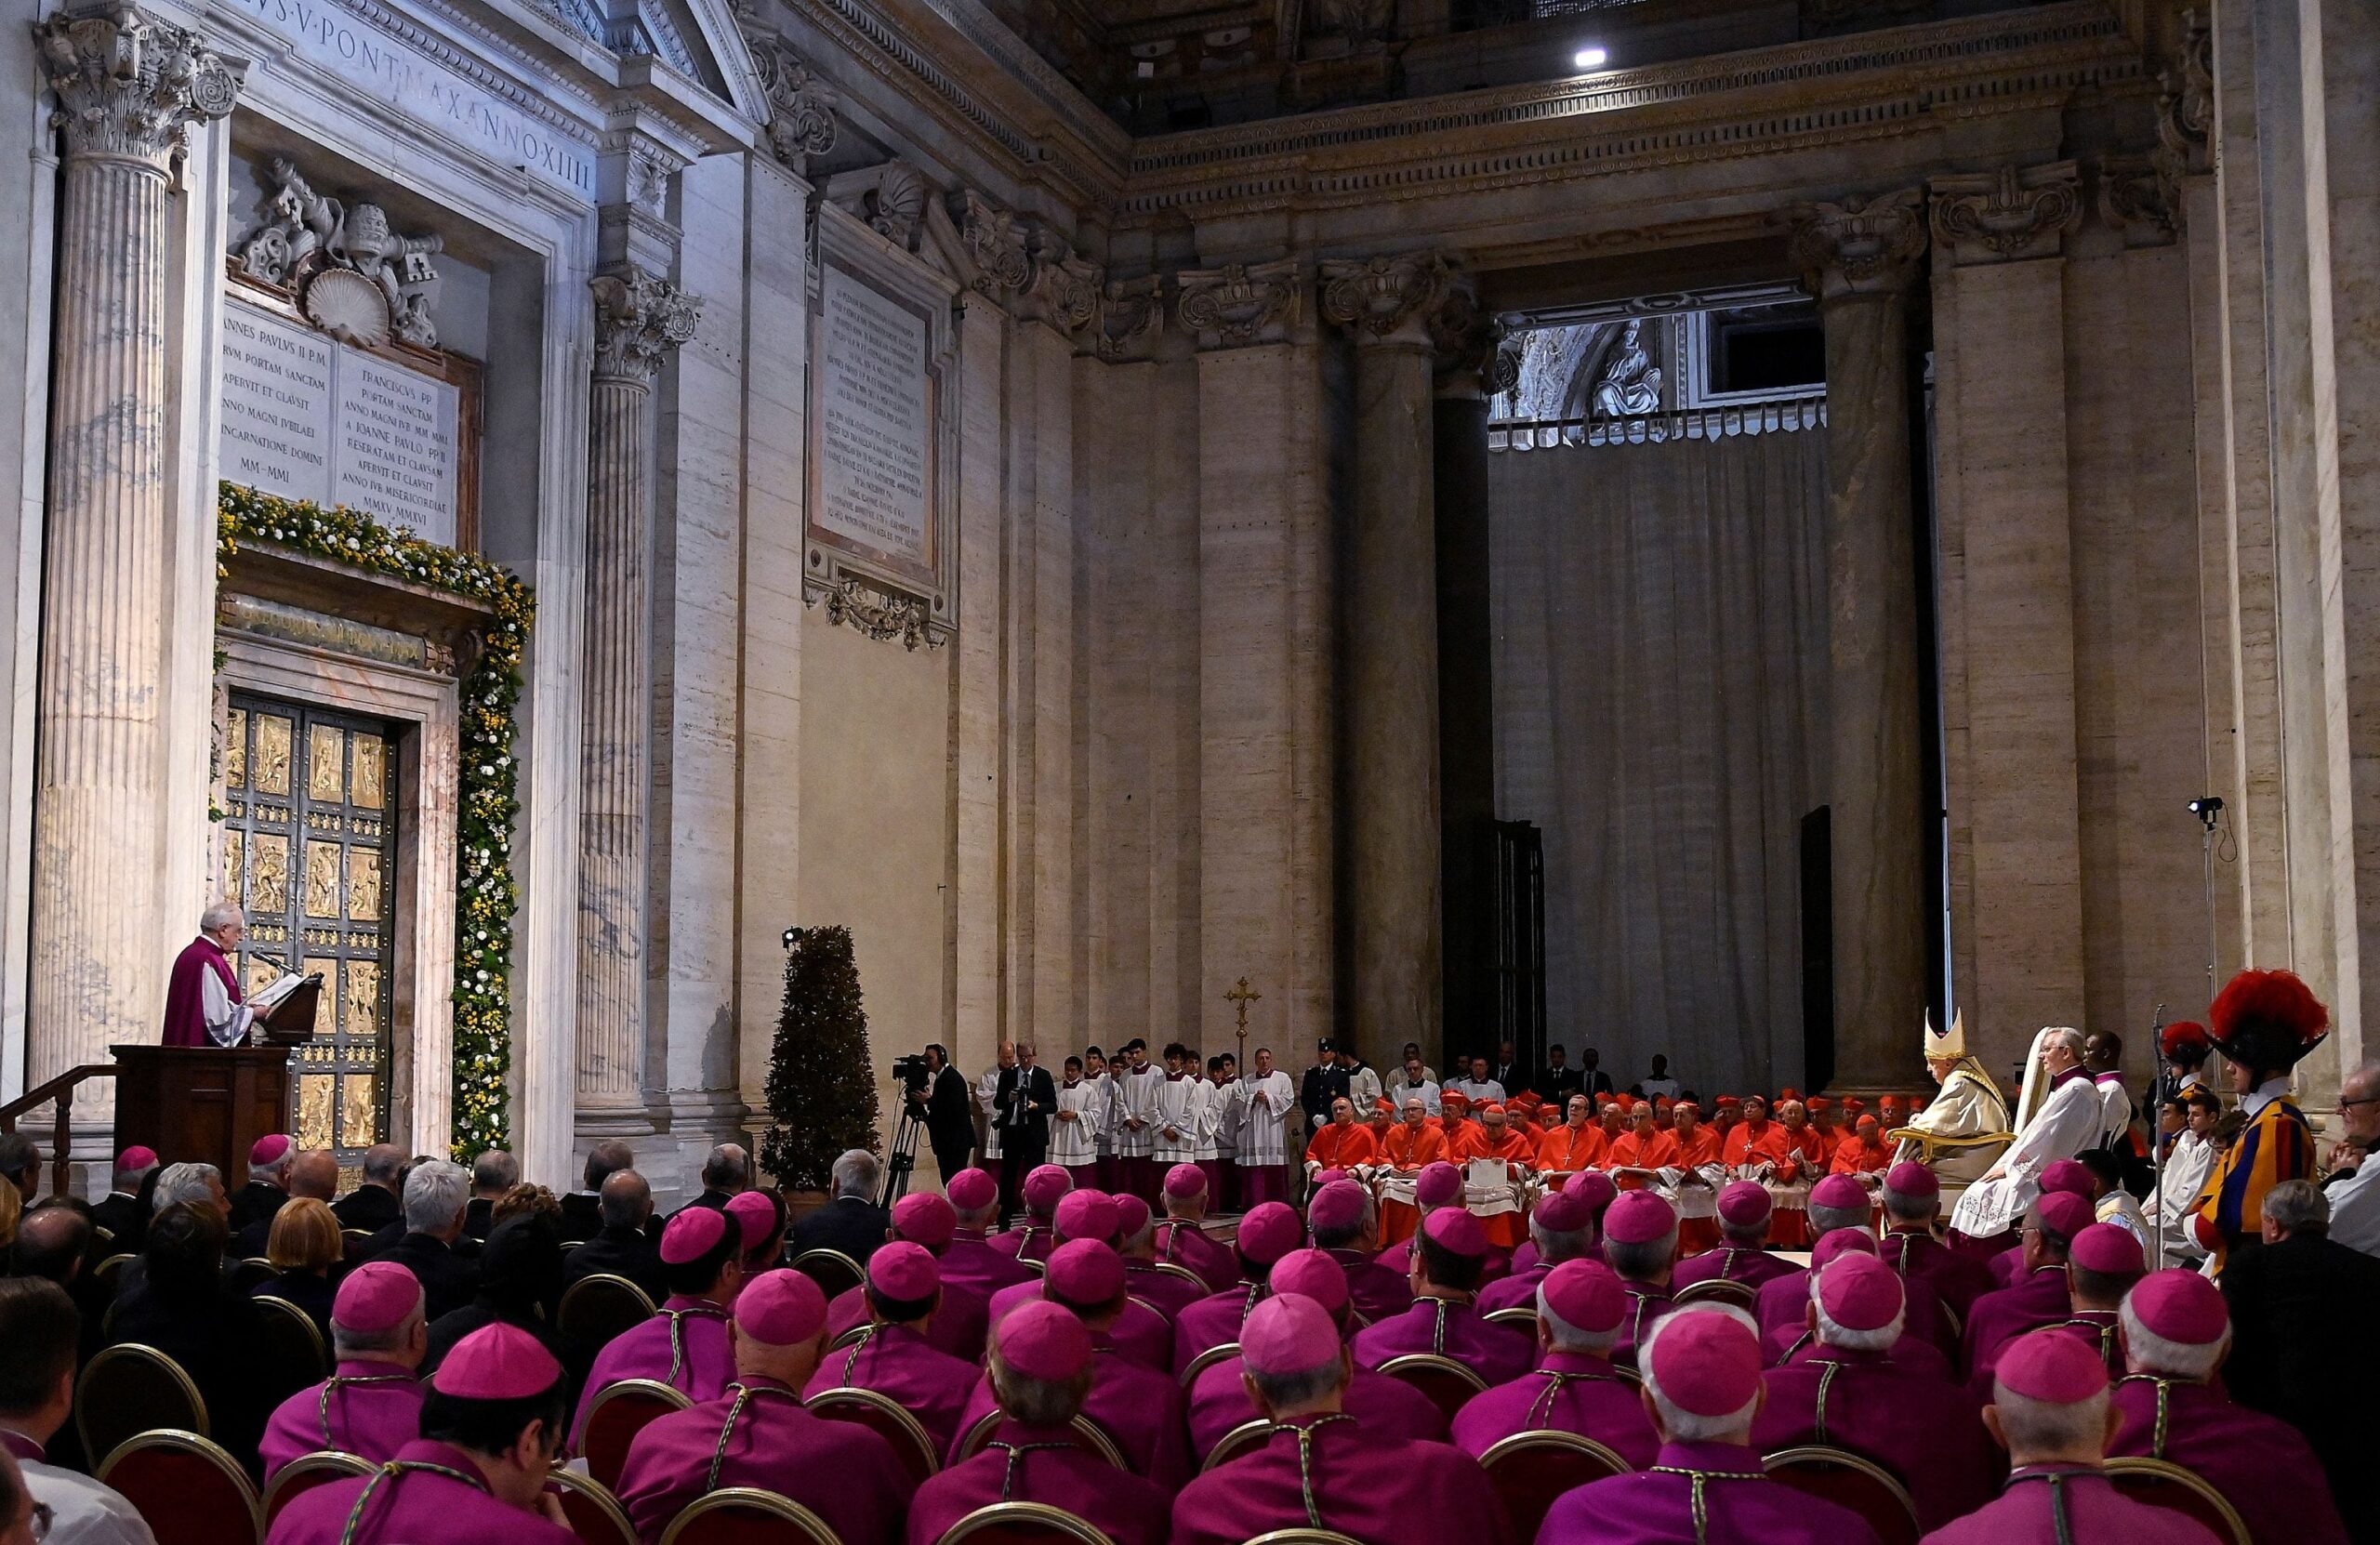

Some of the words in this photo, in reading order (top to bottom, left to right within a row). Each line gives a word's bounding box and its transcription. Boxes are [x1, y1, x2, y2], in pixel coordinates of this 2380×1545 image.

[542, 142, 588, 190] XIIII
[259, 330, 295, 354] PAVLVS
[298, 345, 305, 359] II
[245, 353, 282, 376] PORTAM
[285, 368, 325, 391] SANCTAM
[362, 370, 416, 400] FRANCISCVS
[421, 392, 432, 405] PP
[222, 373, 260, 393] APERVIT
[262, 386, 273, 398] ET
[275, 390, 310, 411] CLAVSIT
[362, 389, 394, 410] PORTAM
[397, 403, 432, 424] SANCTAM
[247, 406, 278, 426] MAGNI
[281, 417, 315, 439] IVBILAEI
[345, 400, 369, 416] ANNO
[371, 409, 397, 428] MAGNI
[221, 423, 287, 455] INCARNATIONE
[291, 447, 323, 466] DOMINI
[346, 420, 351, 430] A
[356, 421, 391, 443] IOANNE
[394, 434, 423, 455] PAVLO
[429, 447, 439, 460] PP
[347, 437, 395, 463] RESERATAM
[398, 455, 406, 467] ET
[408, 459, 443, 480] CLAVSAM
[358, 460, 390, 478] APERVIT
[391, 470, 401, 482] ET
[403, 474, 433, 493] CLAVSIT
[342, 472, 368, 488] ANNO
[370, 480, 383, 493] IVB
[385, 485, 446, 514] MISERICORDIAE
[364, 496, 392, 514] MMXV
[395, 506, 427, 526] MMXVI
